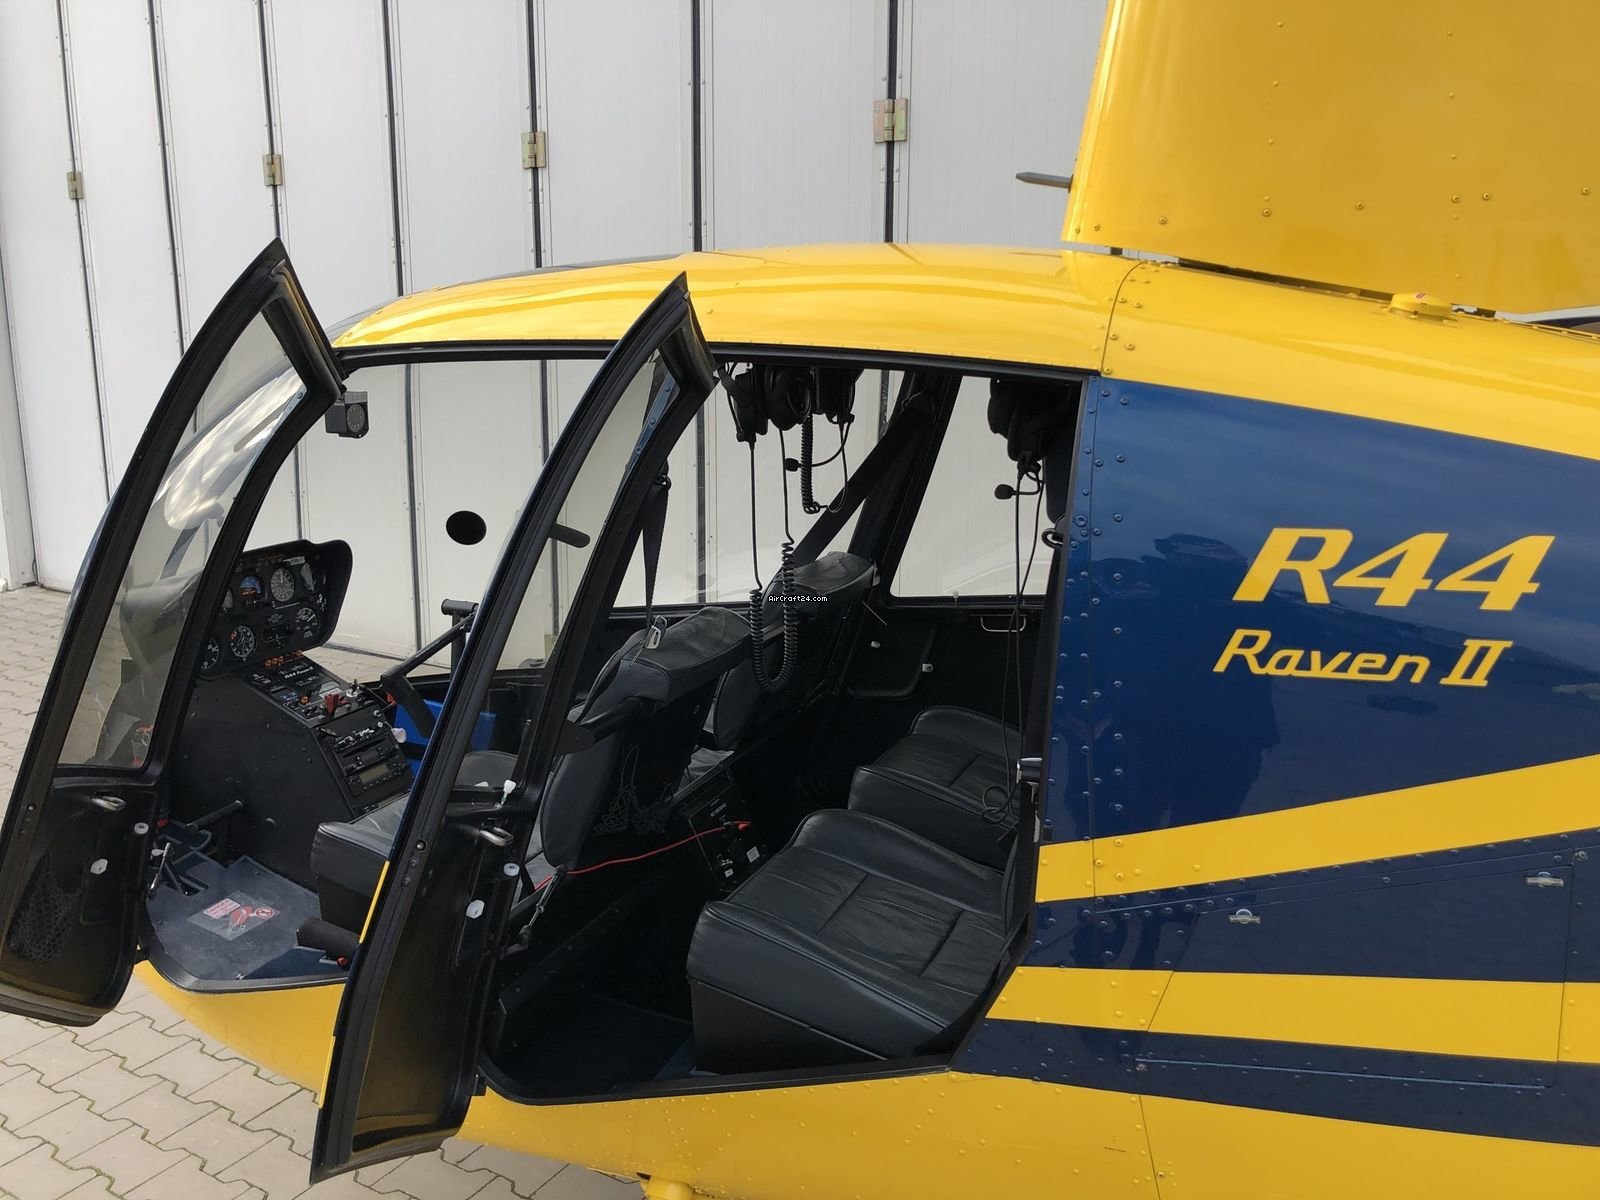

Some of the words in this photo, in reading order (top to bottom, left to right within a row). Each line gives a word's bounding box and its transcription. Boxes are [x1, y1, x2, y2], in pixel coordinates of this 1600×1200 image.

[1232, 527, 1556, 611] R44
[1212, 628, 1431, 683] Raven
[1439, 639, 1513, 687] II
